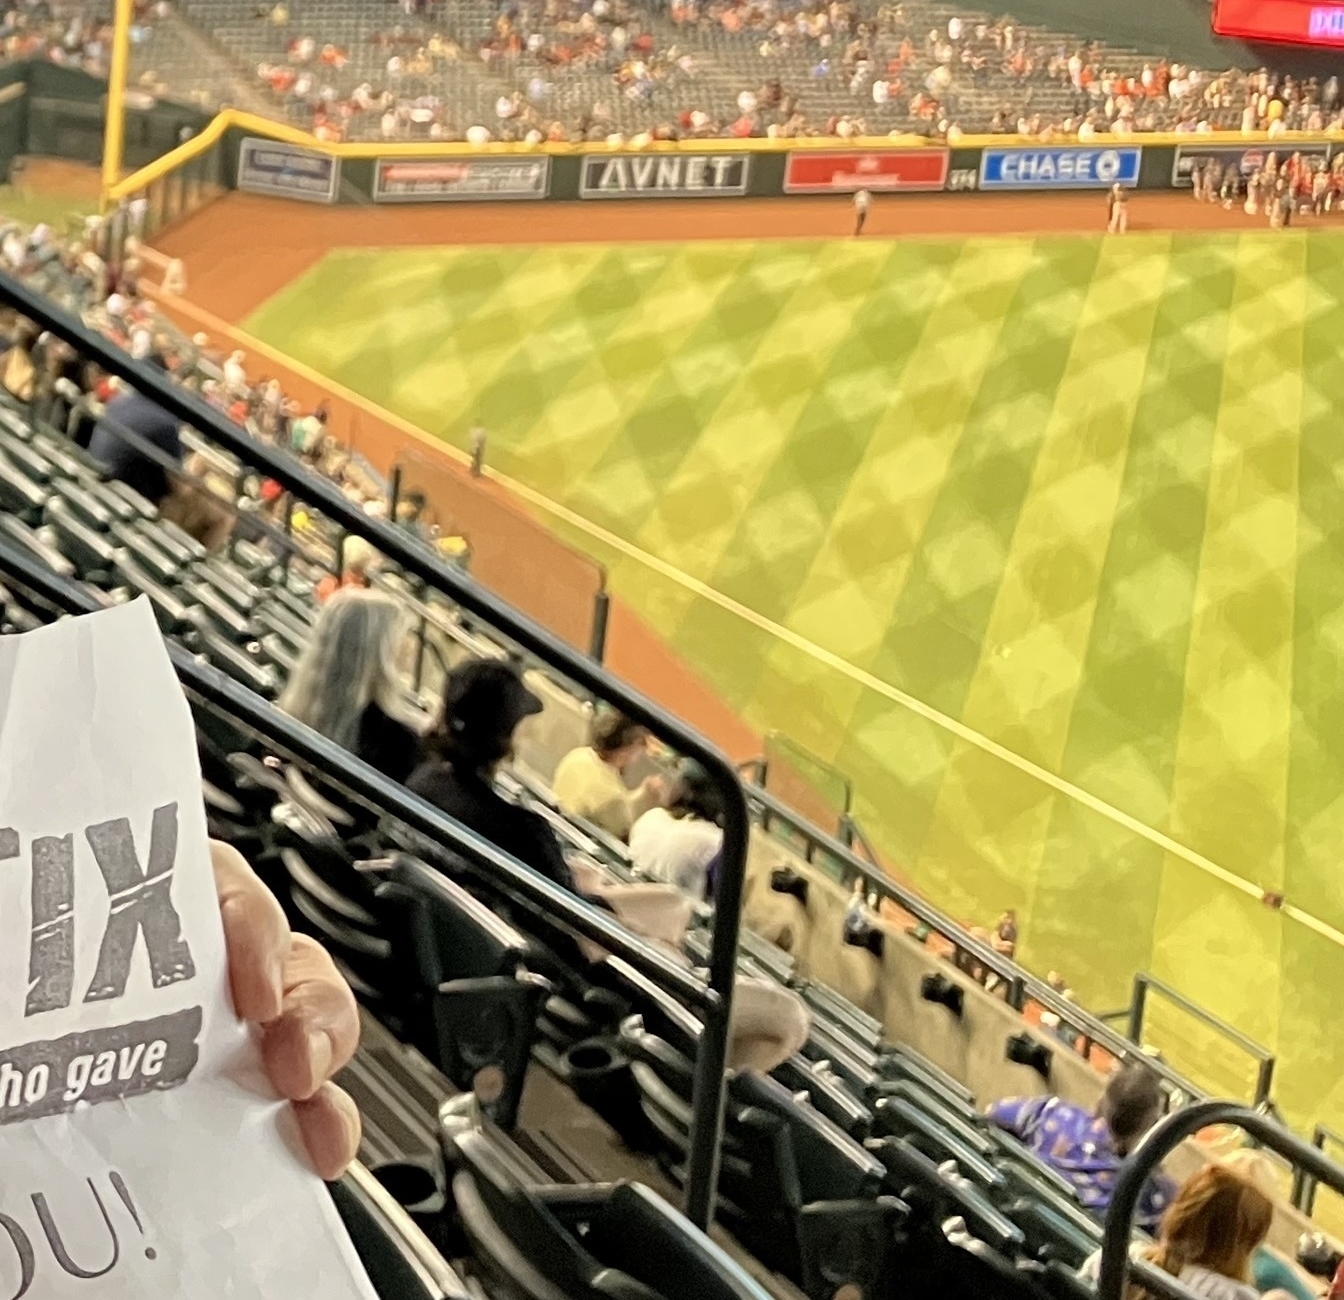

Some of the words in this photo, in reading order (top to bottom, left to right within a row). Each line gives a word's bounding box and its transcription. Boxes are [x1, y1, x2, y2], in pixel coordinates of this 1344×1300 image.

[598, 156, 733, 192] AVNET
[1000, 153, 1092, 181] CHASE
[64, 1036, 166, 1105] gave
